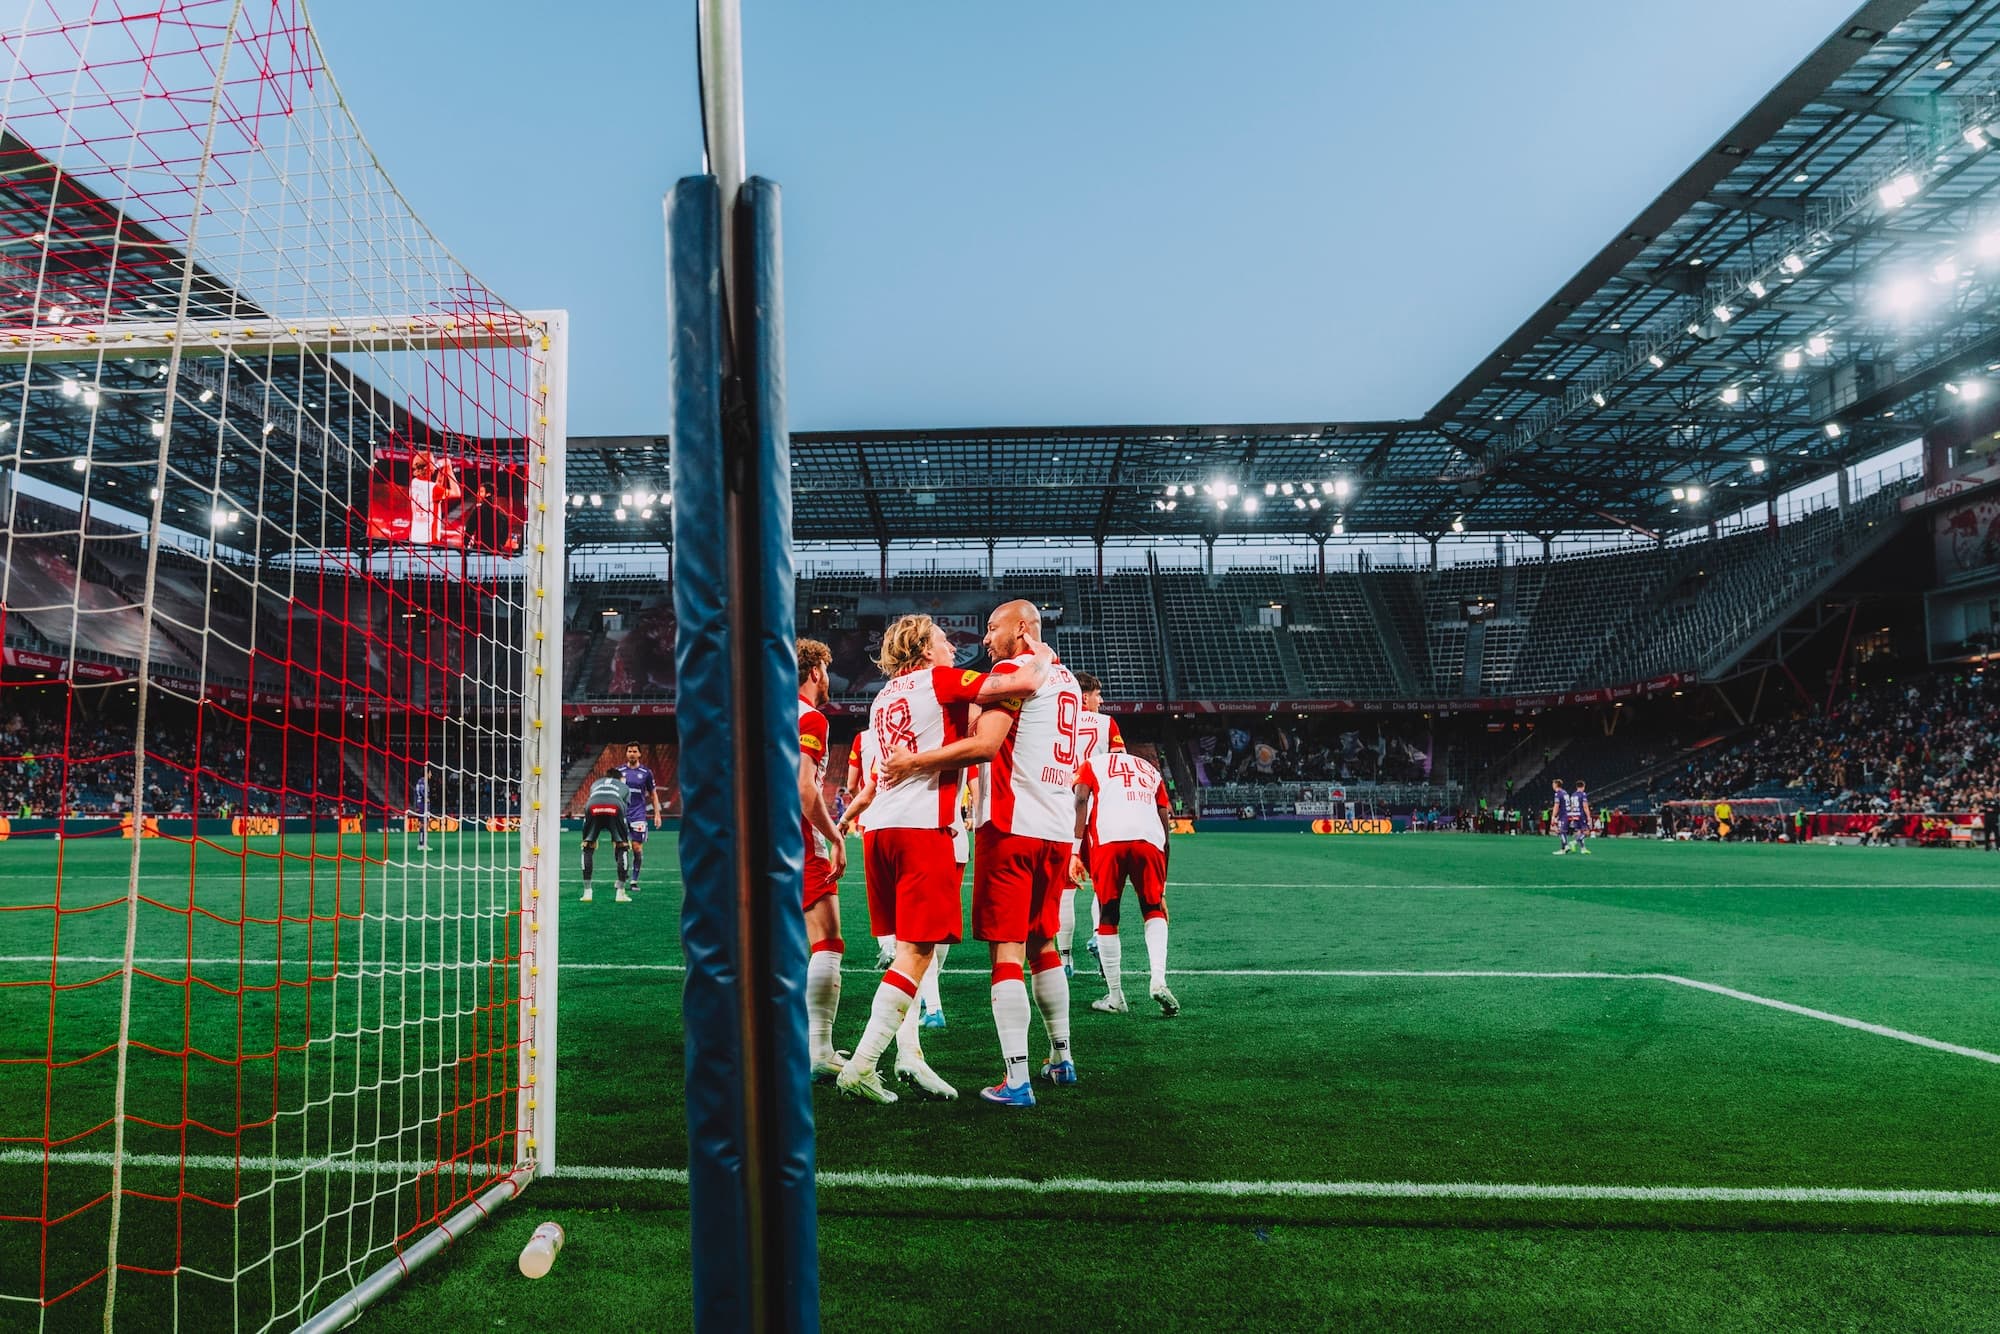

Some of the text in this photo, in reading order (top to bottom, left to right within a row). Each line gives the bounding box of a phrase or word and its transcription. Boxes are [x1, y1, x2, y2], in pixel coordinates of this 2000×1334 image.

[936, 616, 976, 627] Bull
[849, 704, 868, 713] Goal
[874, 697, 918, 760] 18
[1054, 691, 1078, 765] 9
[1334, 820, 1381, 833] RAUCH
